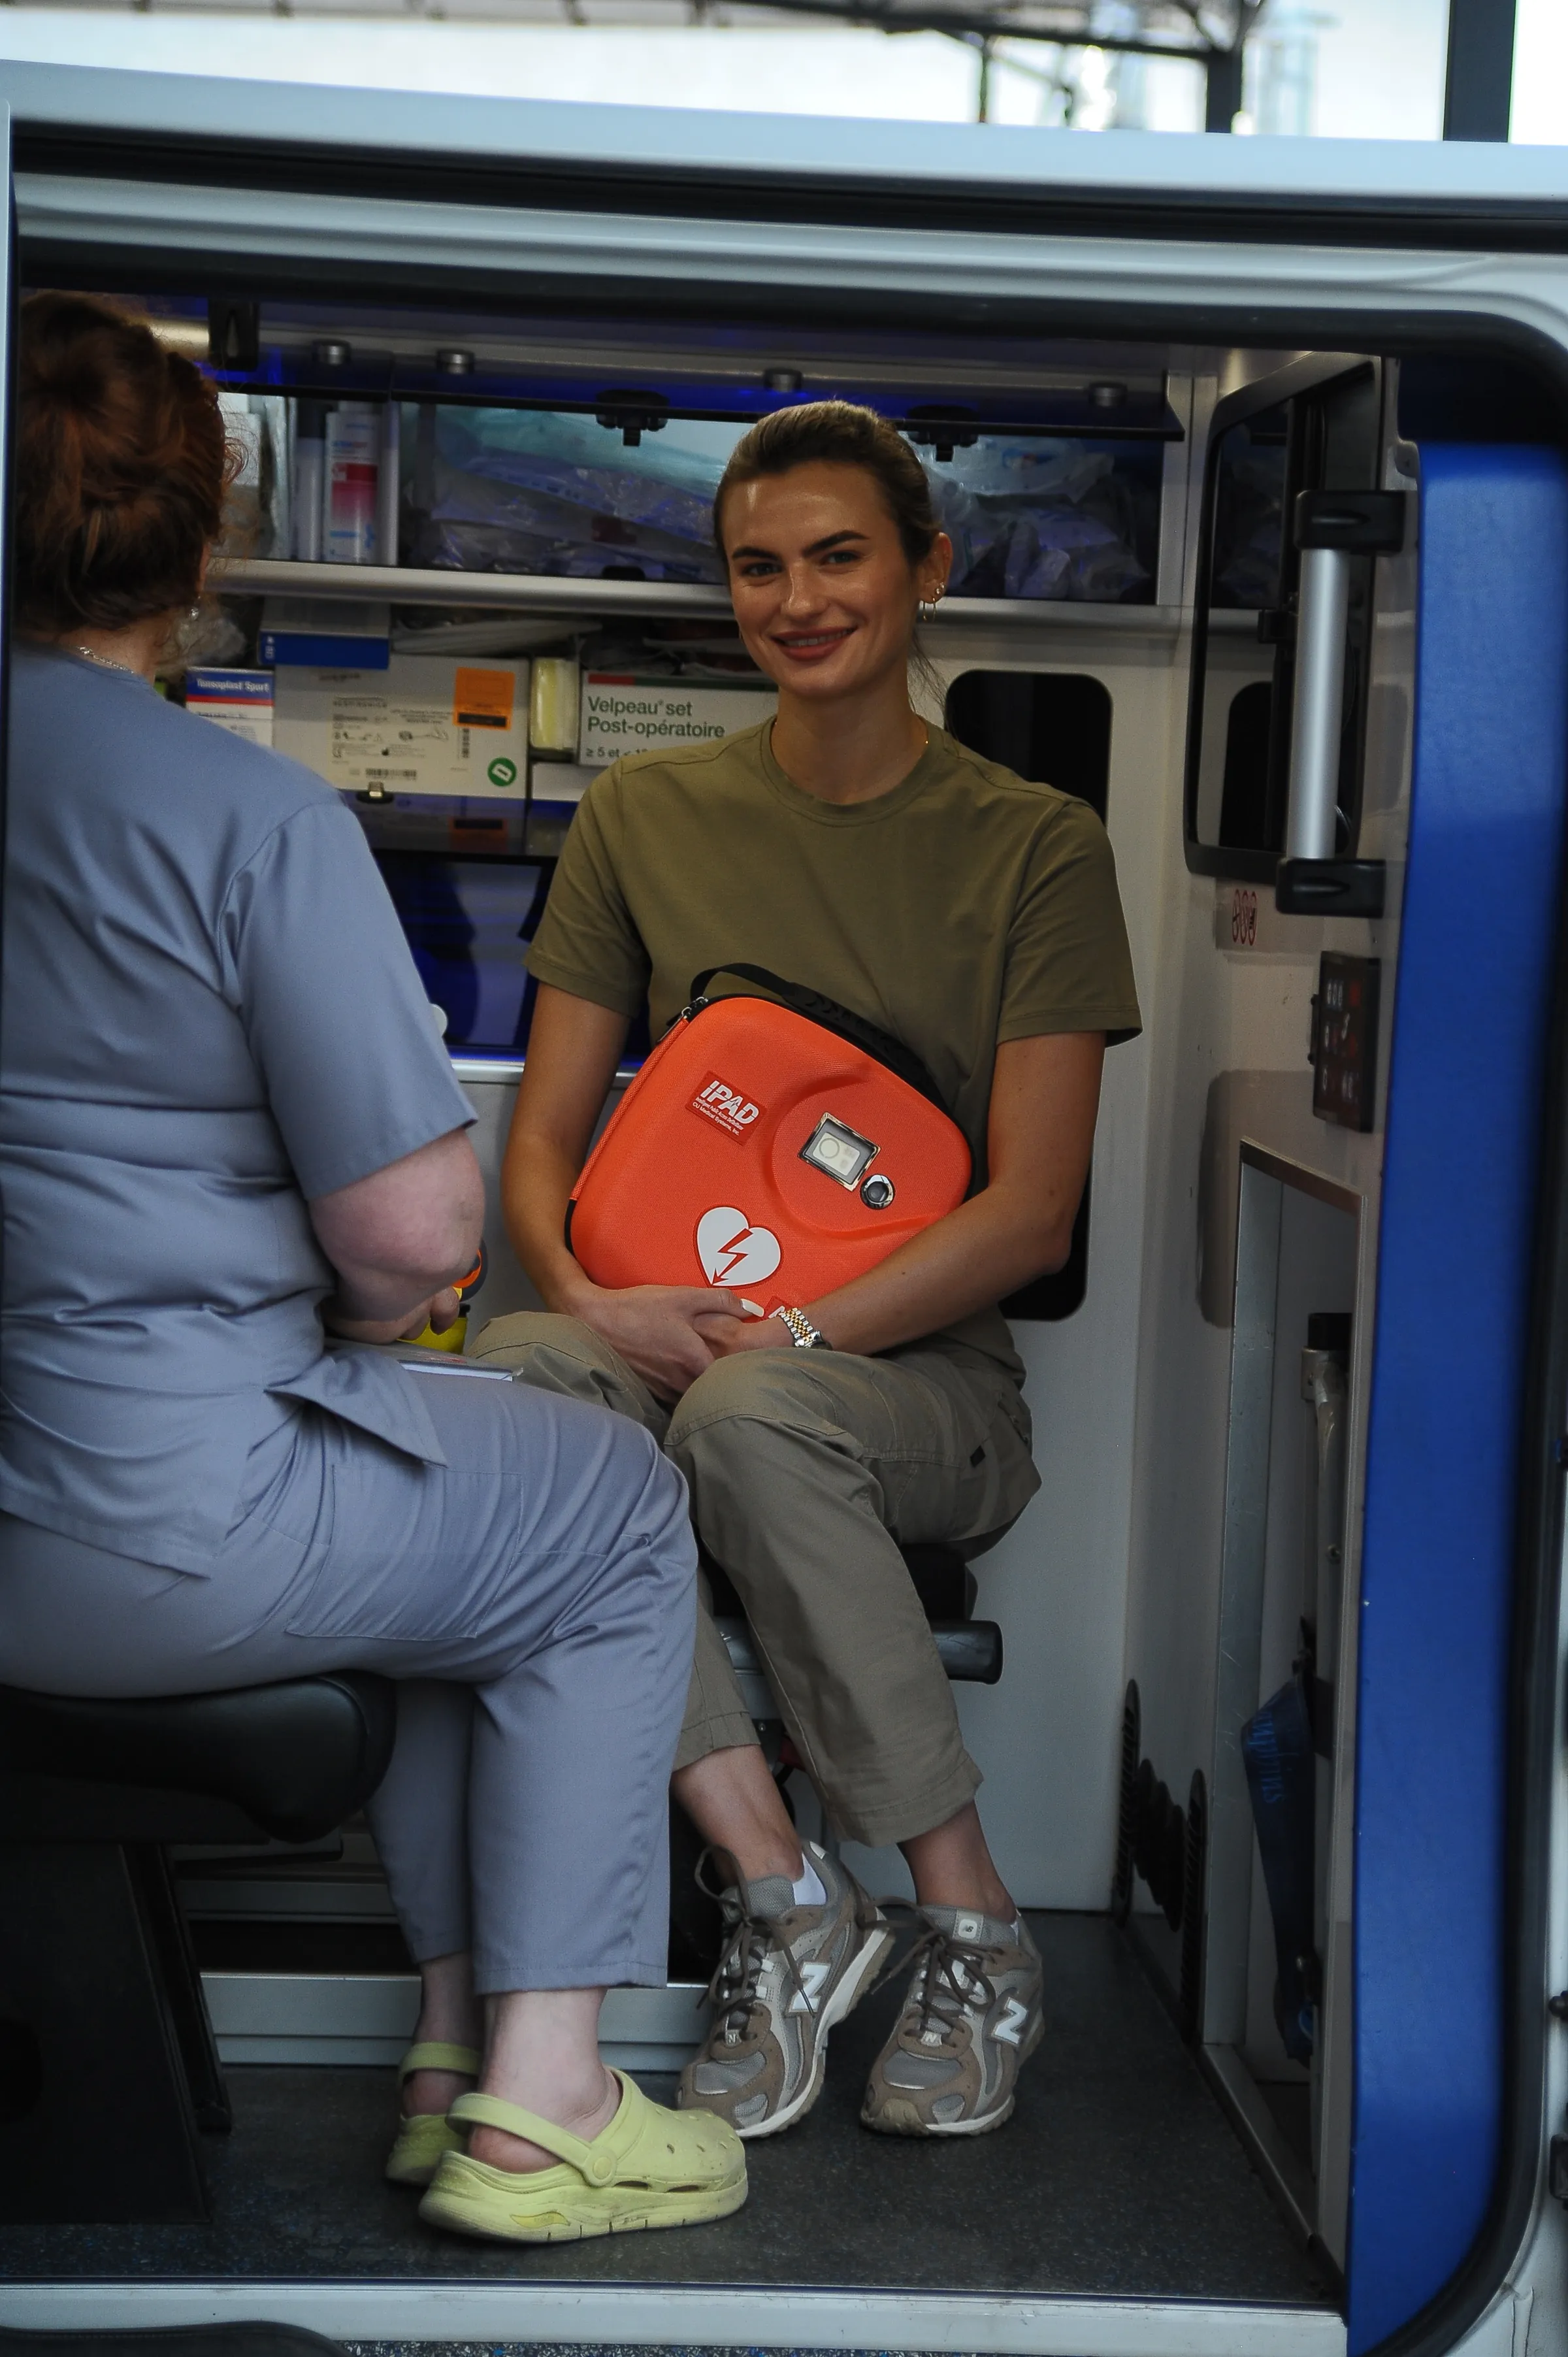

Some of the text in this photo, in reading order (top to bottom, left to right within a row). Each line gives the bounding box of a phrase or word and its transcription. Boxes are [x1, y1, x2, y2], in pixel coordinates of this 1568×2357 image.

[666, 701, 693, 716] set
[588, 716, 725, 738] Post-opératoire
[699, 1106, 716, 1119] Medical
[727, 2033, 738, 2044] N
